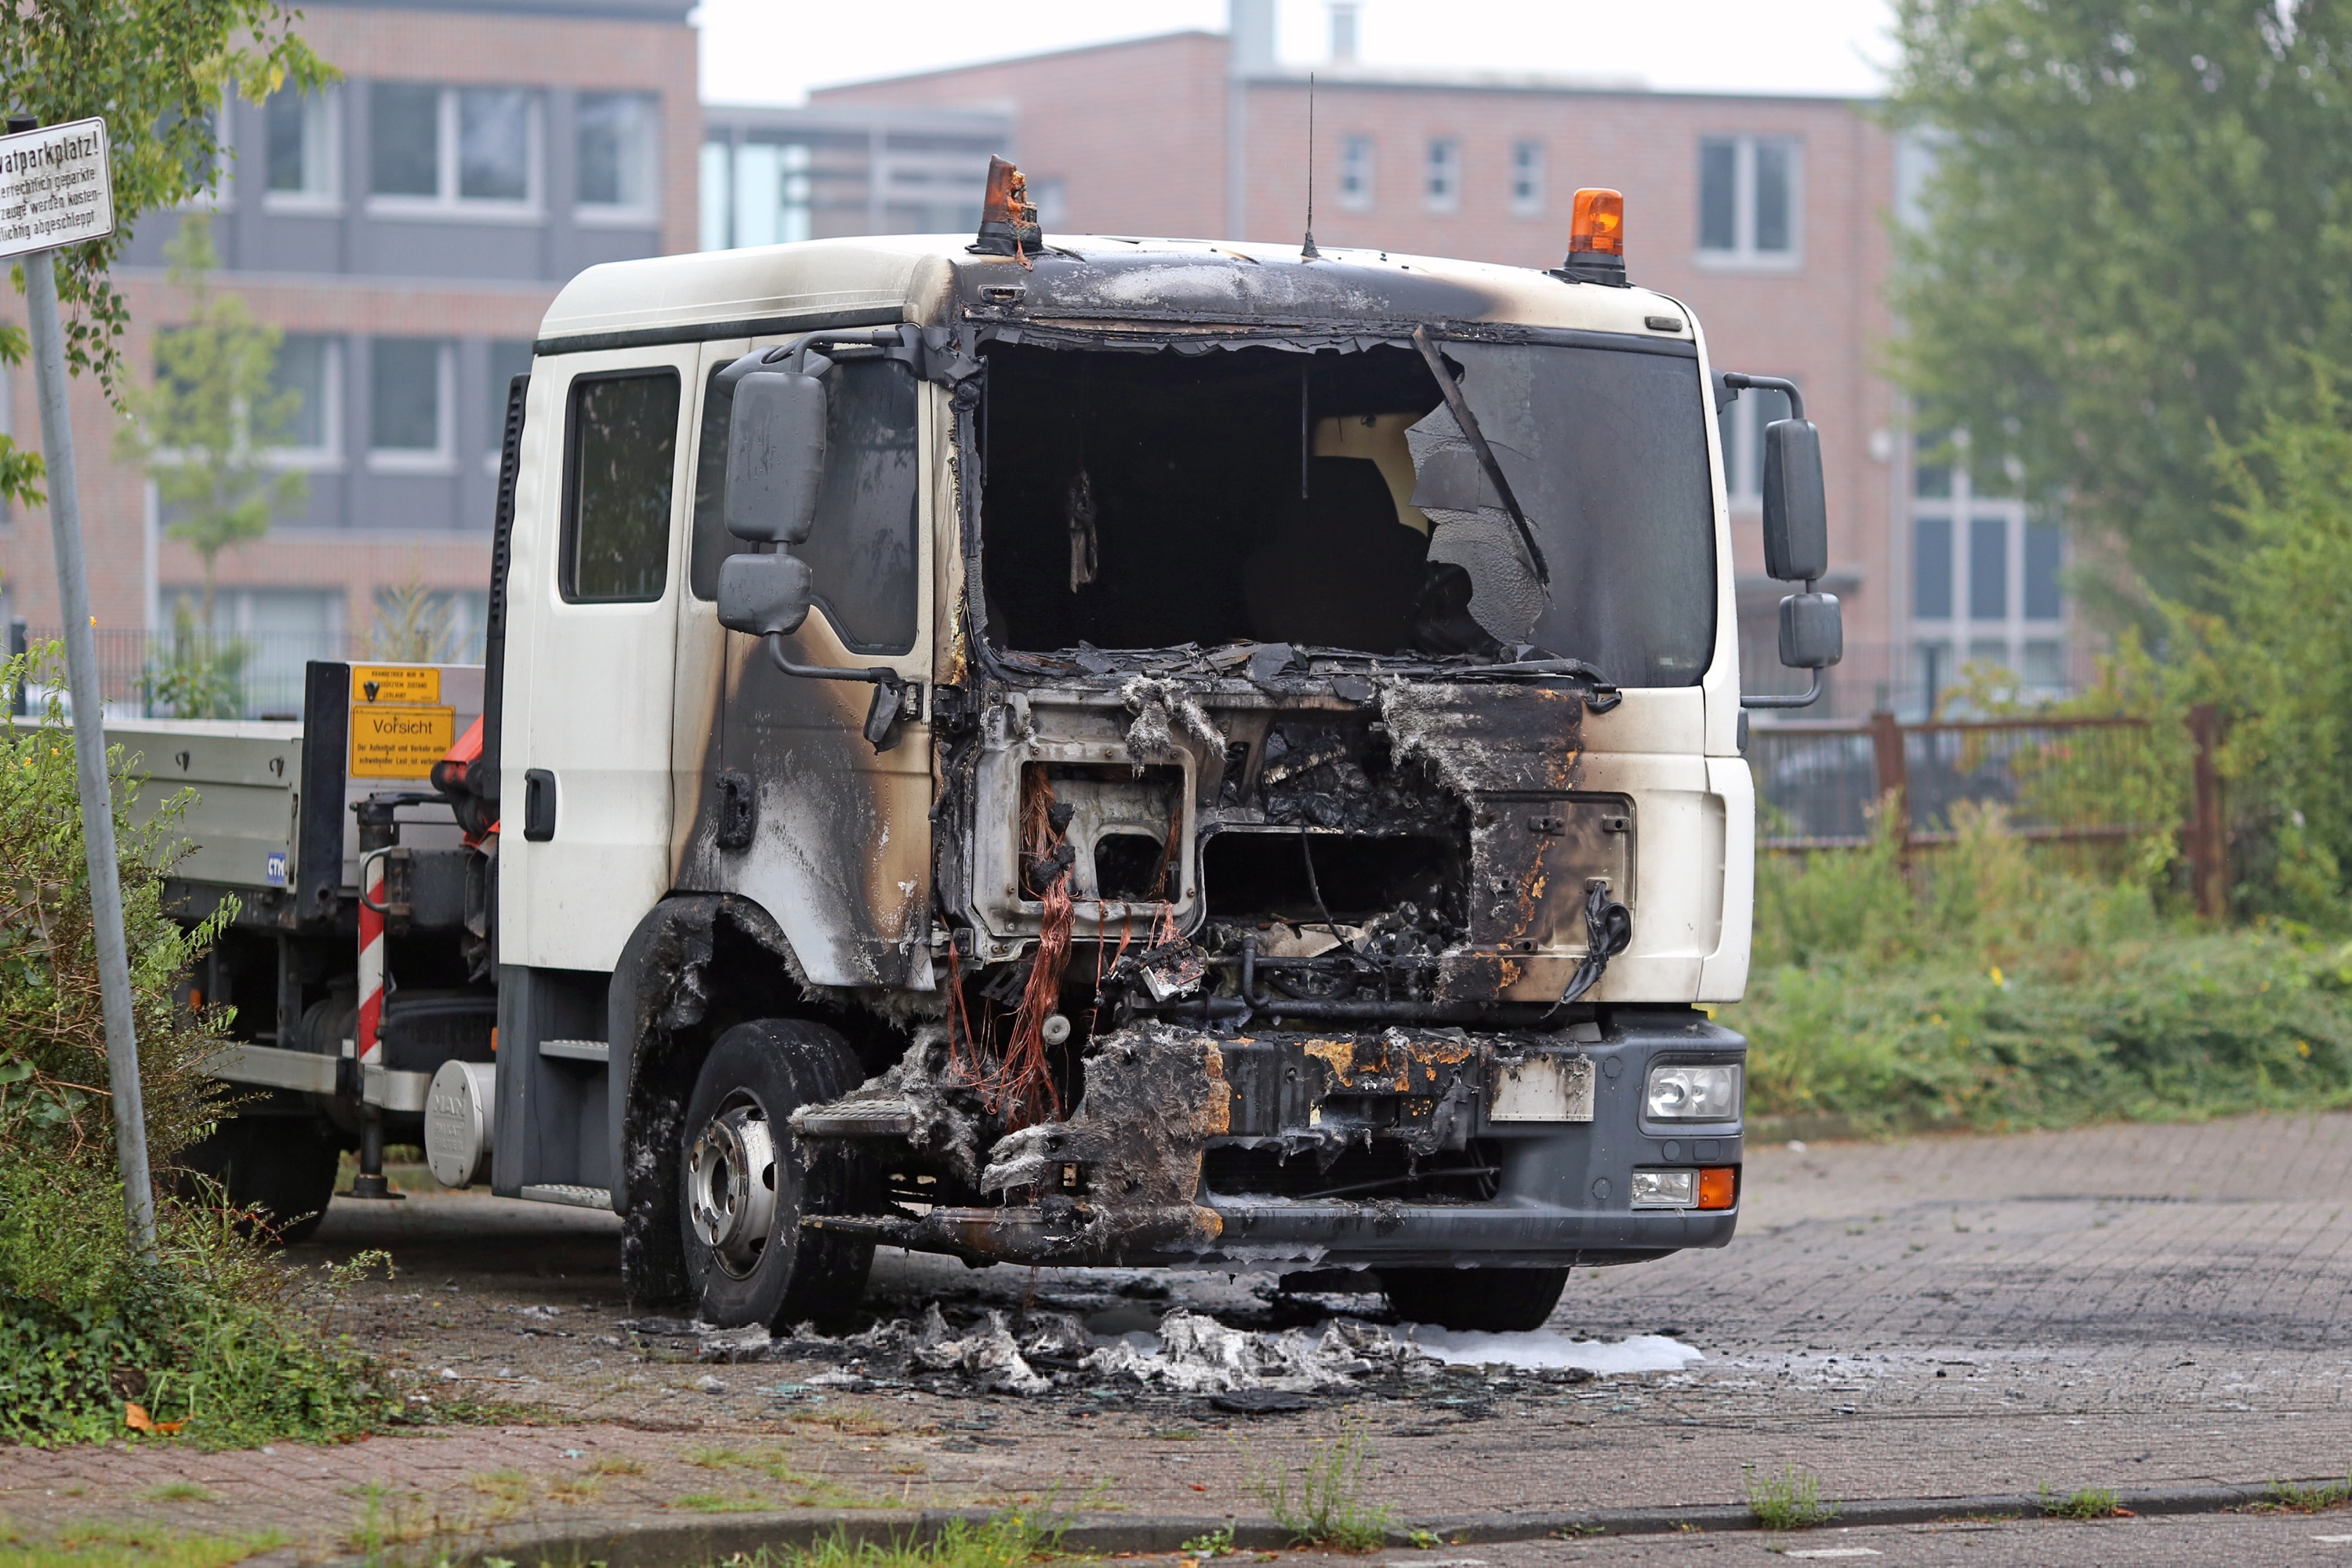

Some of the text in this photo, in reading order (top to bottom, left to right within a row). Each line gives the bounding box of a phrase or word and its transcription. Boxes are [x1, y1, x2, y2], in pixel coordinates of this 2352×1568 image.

[55, 168, 96, 192] geparkte
[30, 194, 64, 214] werden
[67, 190, 103, 207] kosten-
[34, 209, 95, 235] abgeschleppt
[373, 718, 433, 735] Vorsicht
[434, 1094, 466, 1116] MAN
